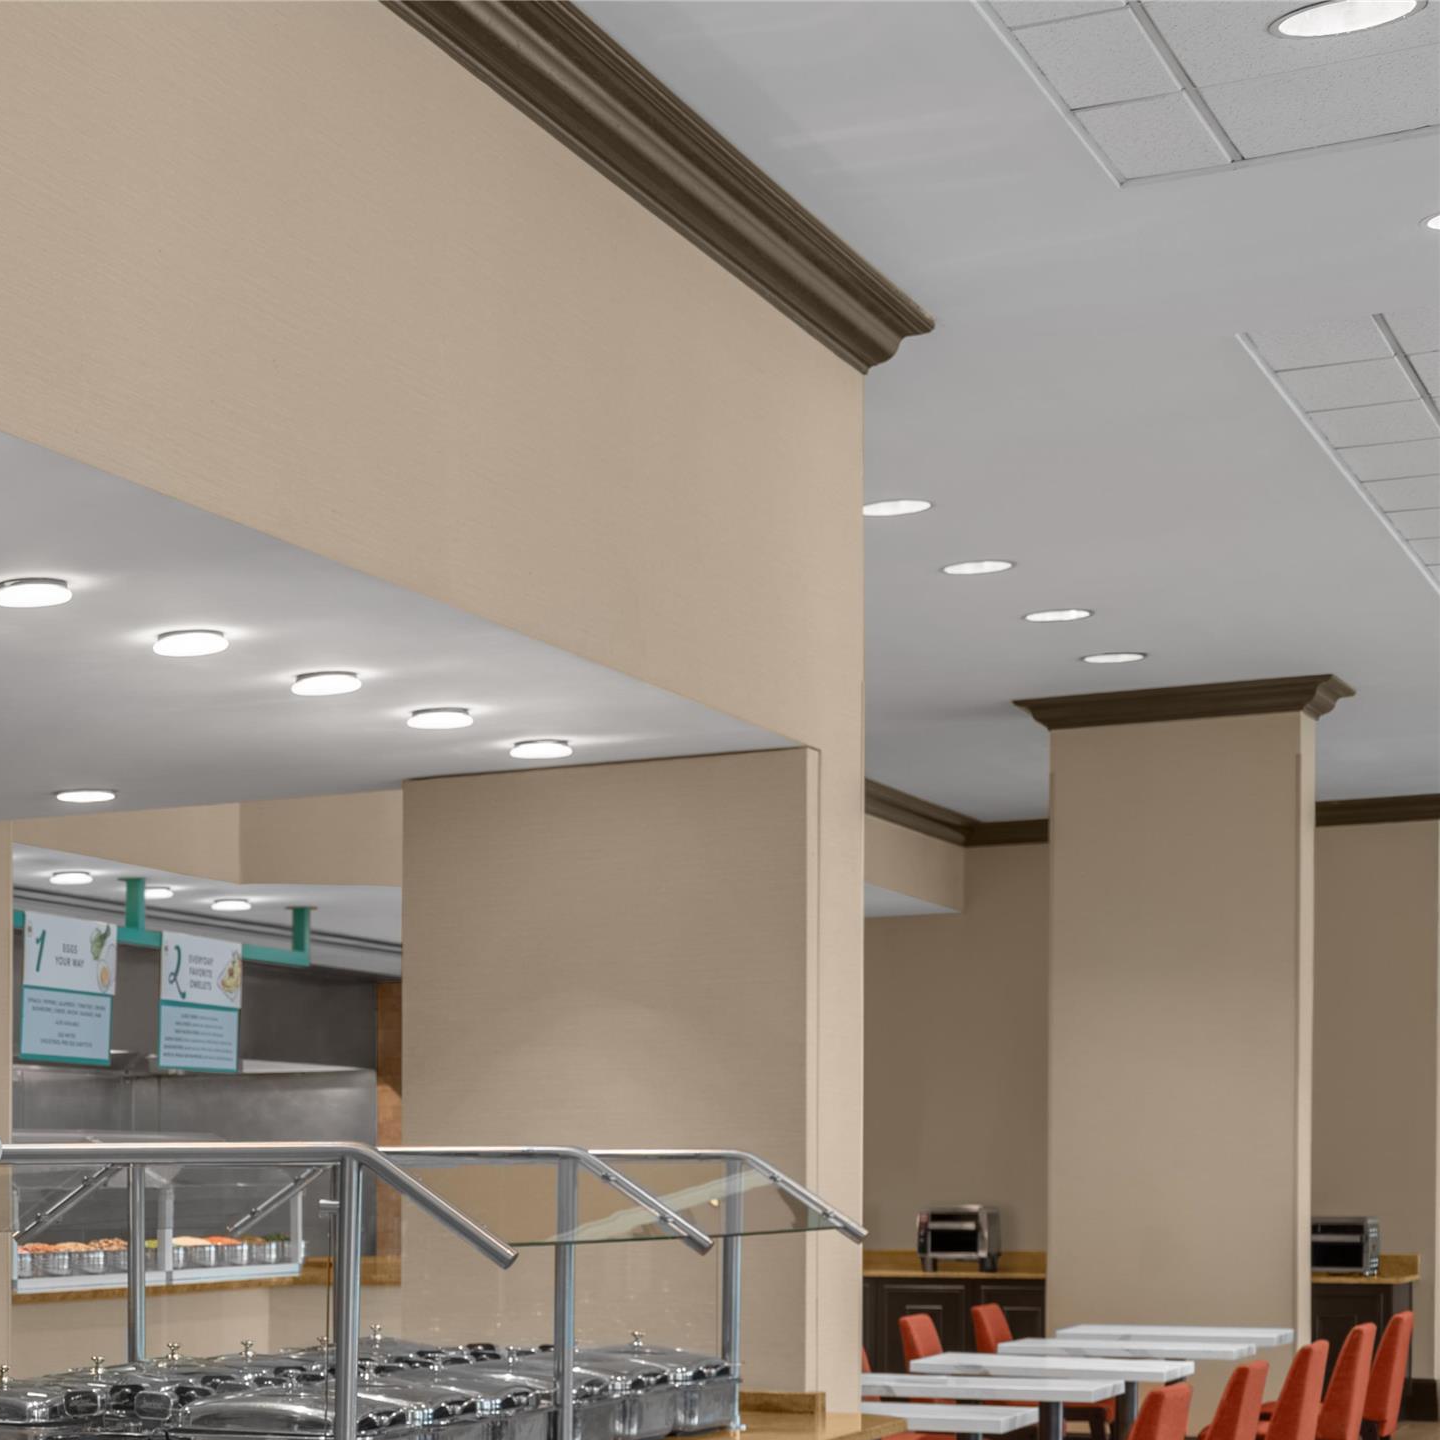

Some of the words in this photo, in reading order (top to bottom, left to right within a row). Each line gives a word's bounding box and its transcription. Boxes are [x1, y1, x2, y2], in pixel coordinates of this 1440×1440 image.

[35, 929, 46, 973] 1
[55, 956, 71, 967] YOUR
[72, 958, 85, 968] WAY
[168, 944, 186, 1000] 2
